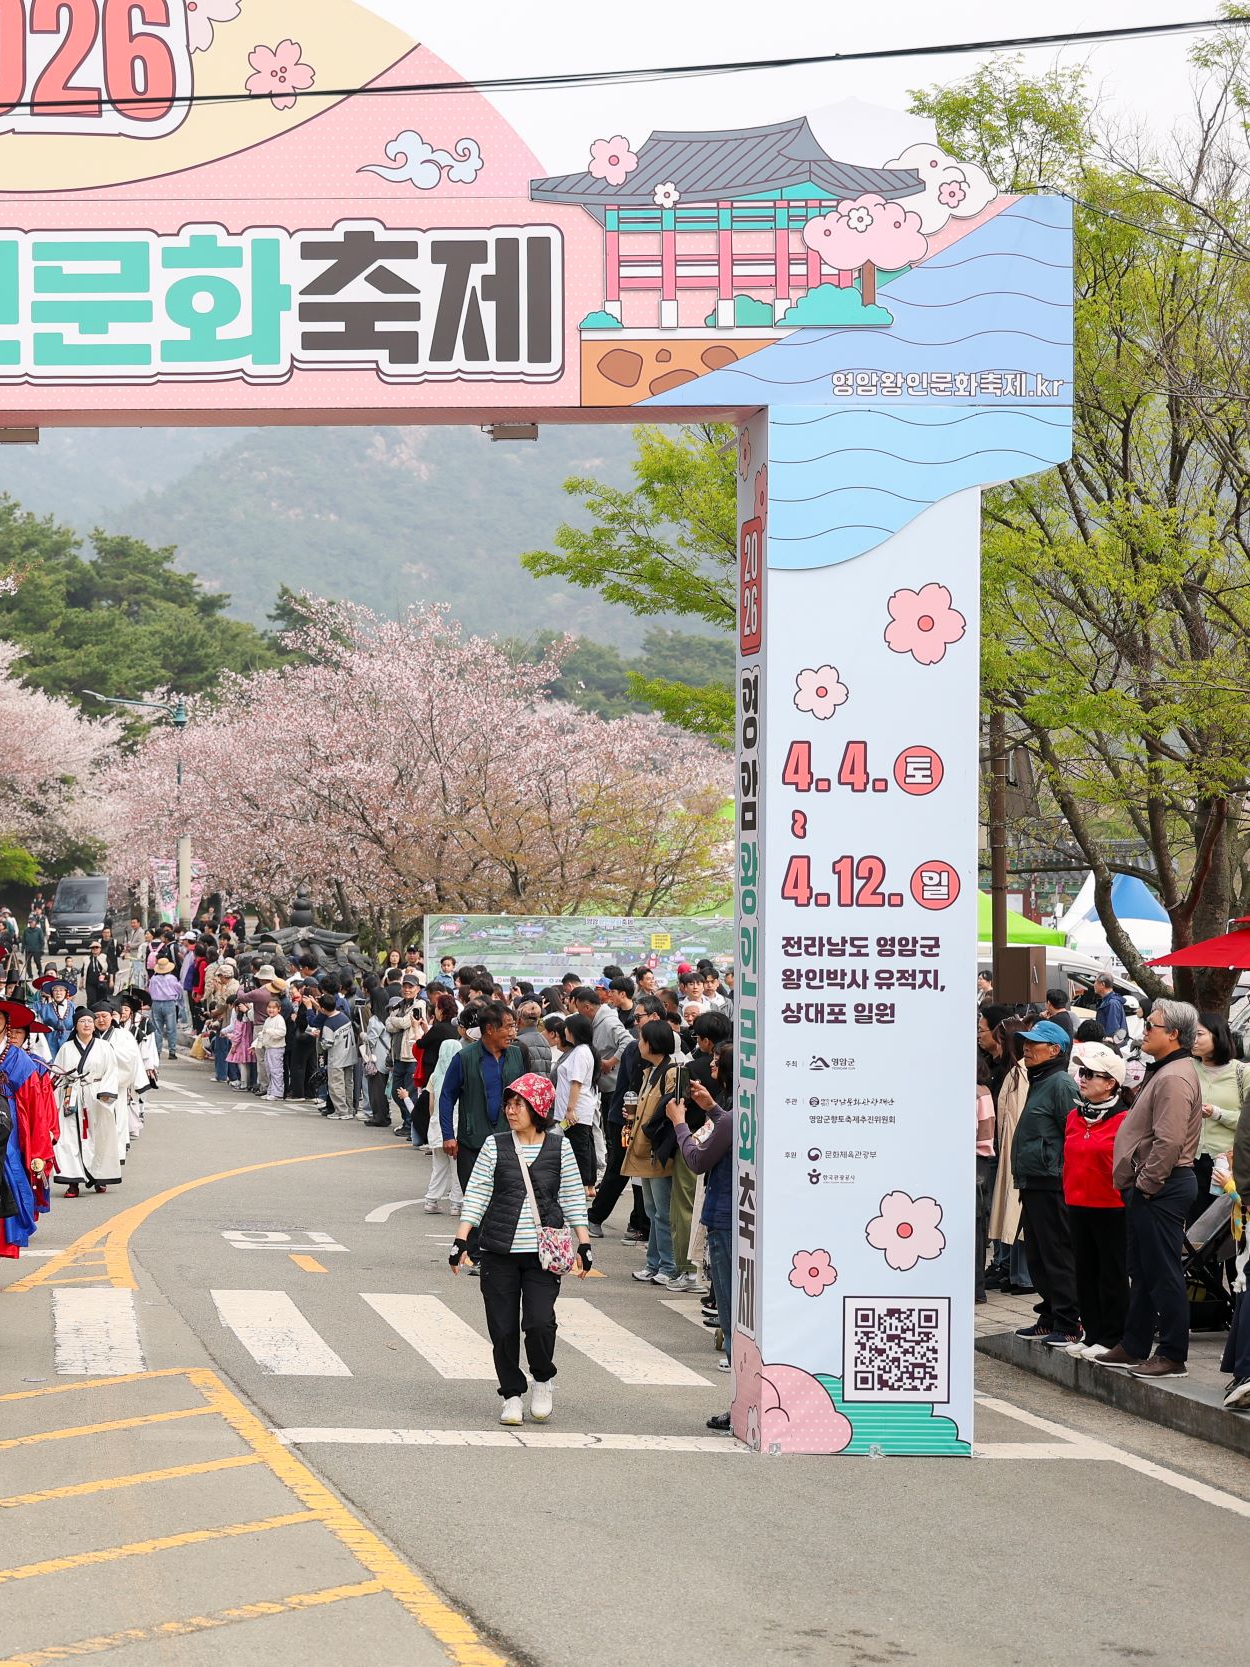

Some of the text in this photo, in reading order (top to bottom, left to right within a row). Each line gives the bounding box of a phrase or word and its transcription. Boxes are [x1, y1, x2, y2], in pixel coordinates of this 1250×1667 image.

[831, 371, 1064, 398] 영암왕인문화축제.kr
[743, 530, 758, 584] 20
[743, 584, 758, 637] 26
[781, 739, 888, 793] 4.4.
[780, 855, 904, 908] 4.12.
[781, 935, 941, 959] 전라남도 영암군
[781, 968, 947, 994] 왕인박사 유적지,
[738, 674, 758, 1332] 영암왕인문화축제
[781, 1002, 896, 1025] 상대포 일원
[785, 1057, 856, 1068] 주최 영암군
[809, 1115, 896, 1124] 영암군향토축제추진위원회
[784, 1150, 877, 1159] 후원 문화체육관광부
